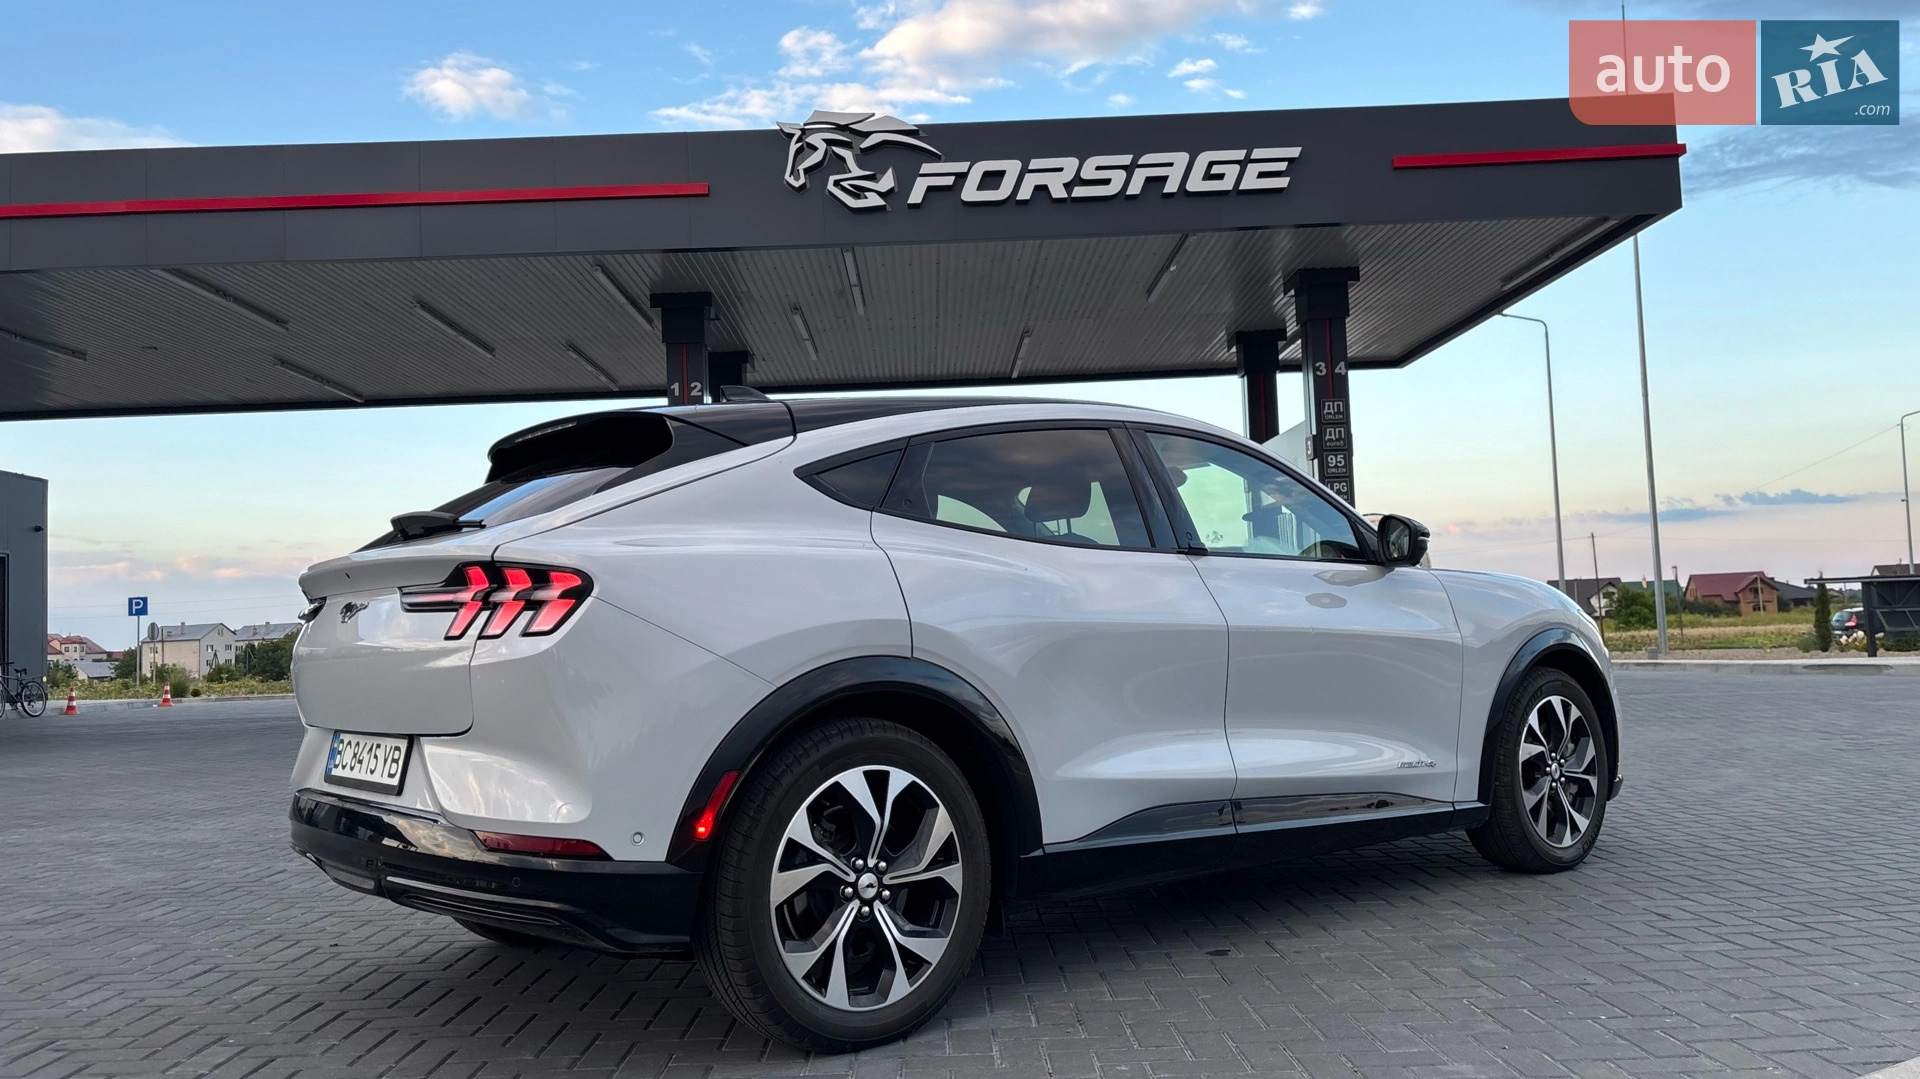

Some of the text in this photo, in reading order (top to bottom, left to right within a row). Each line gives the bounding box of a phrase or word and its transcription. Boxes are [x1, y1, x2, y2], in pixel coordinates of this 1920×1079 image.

[907, 147, 1302, 208] FORSAGE
[1315, 361, 1347, 376] 3 4
[670, 382, 702, 396] 1 2
[1324, 401, 1343, 414] ДП
[1325, 428, 1345, 440] ДП
[1307, 440, 1312, 455] 3
[1327, 454, 1345, 467] 95
[132, 599, 144, 615] P
